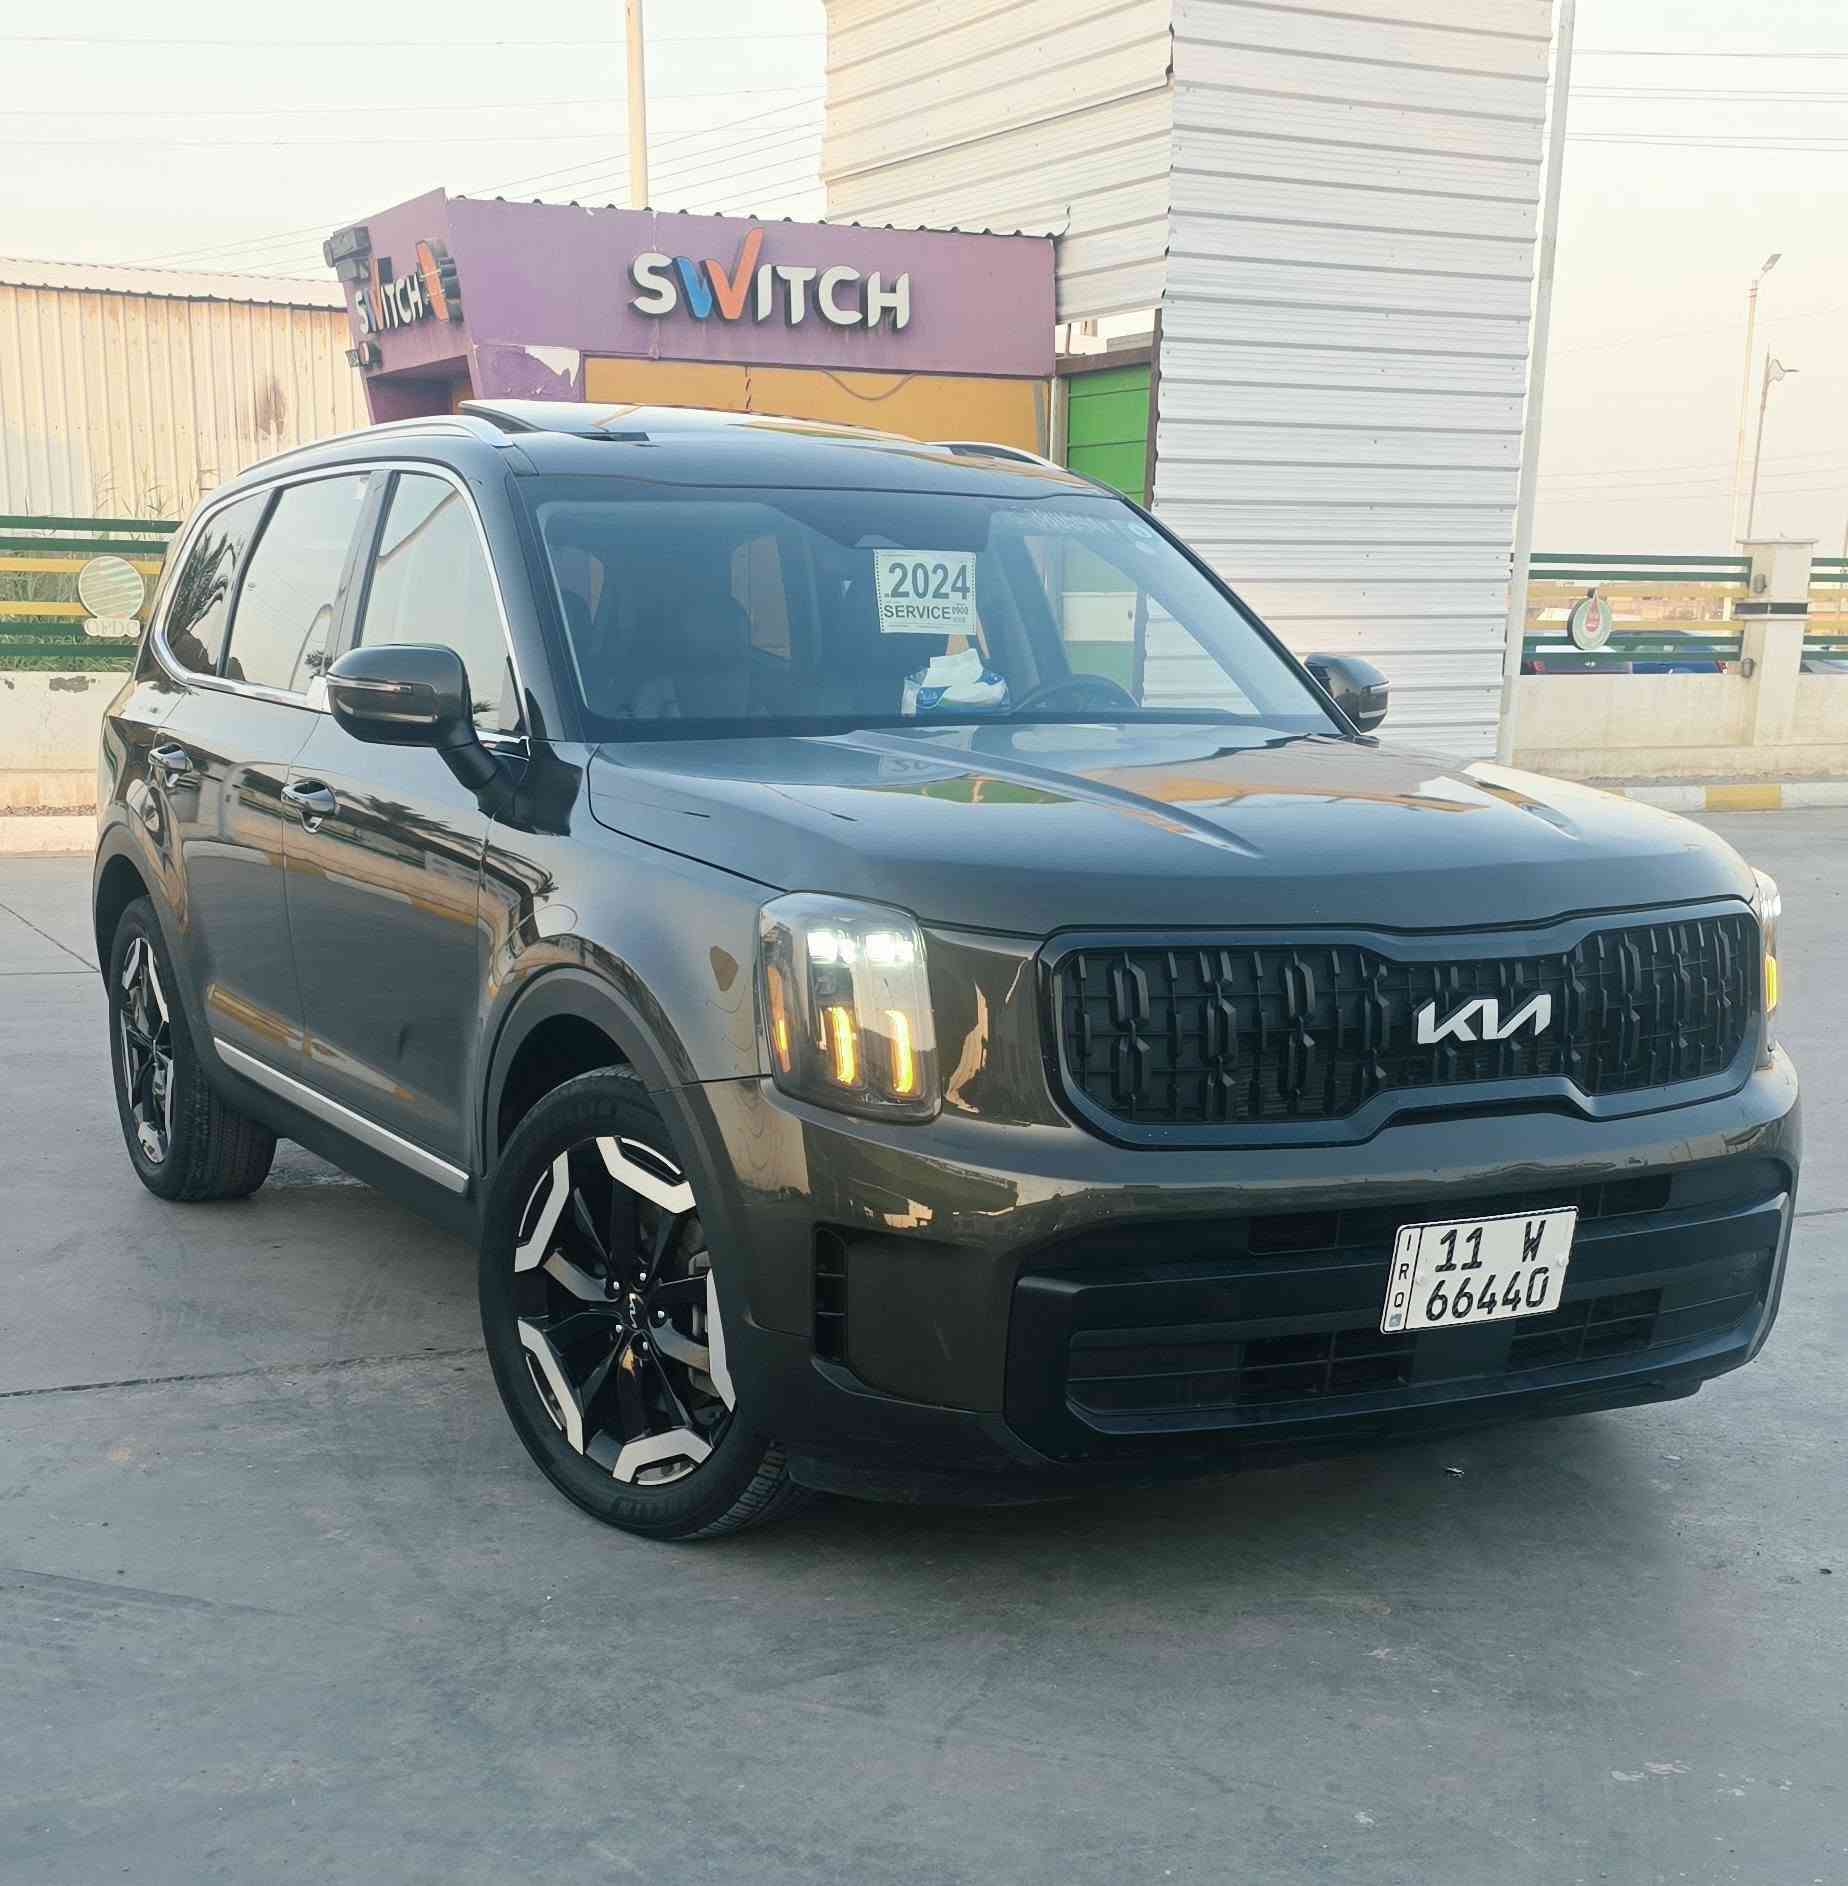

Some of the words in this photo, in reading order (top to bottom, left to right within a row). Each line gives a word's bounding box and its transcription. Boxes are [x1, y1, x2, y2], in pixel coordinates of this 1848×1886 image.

[355, 256, 423, 334] SWITCH
[630, 227, 910, 329] SWITCH
[888, 562, 970, 600] 2024
[884, 604, 951, 620] SERVICE
[1417, 994, 1551, 1044] KIA
[1434, 1226, 1484, 1273] 11
[1521, 1219, 1547, 1263] W
[1425, 1266, 1550, 1322] 66440
